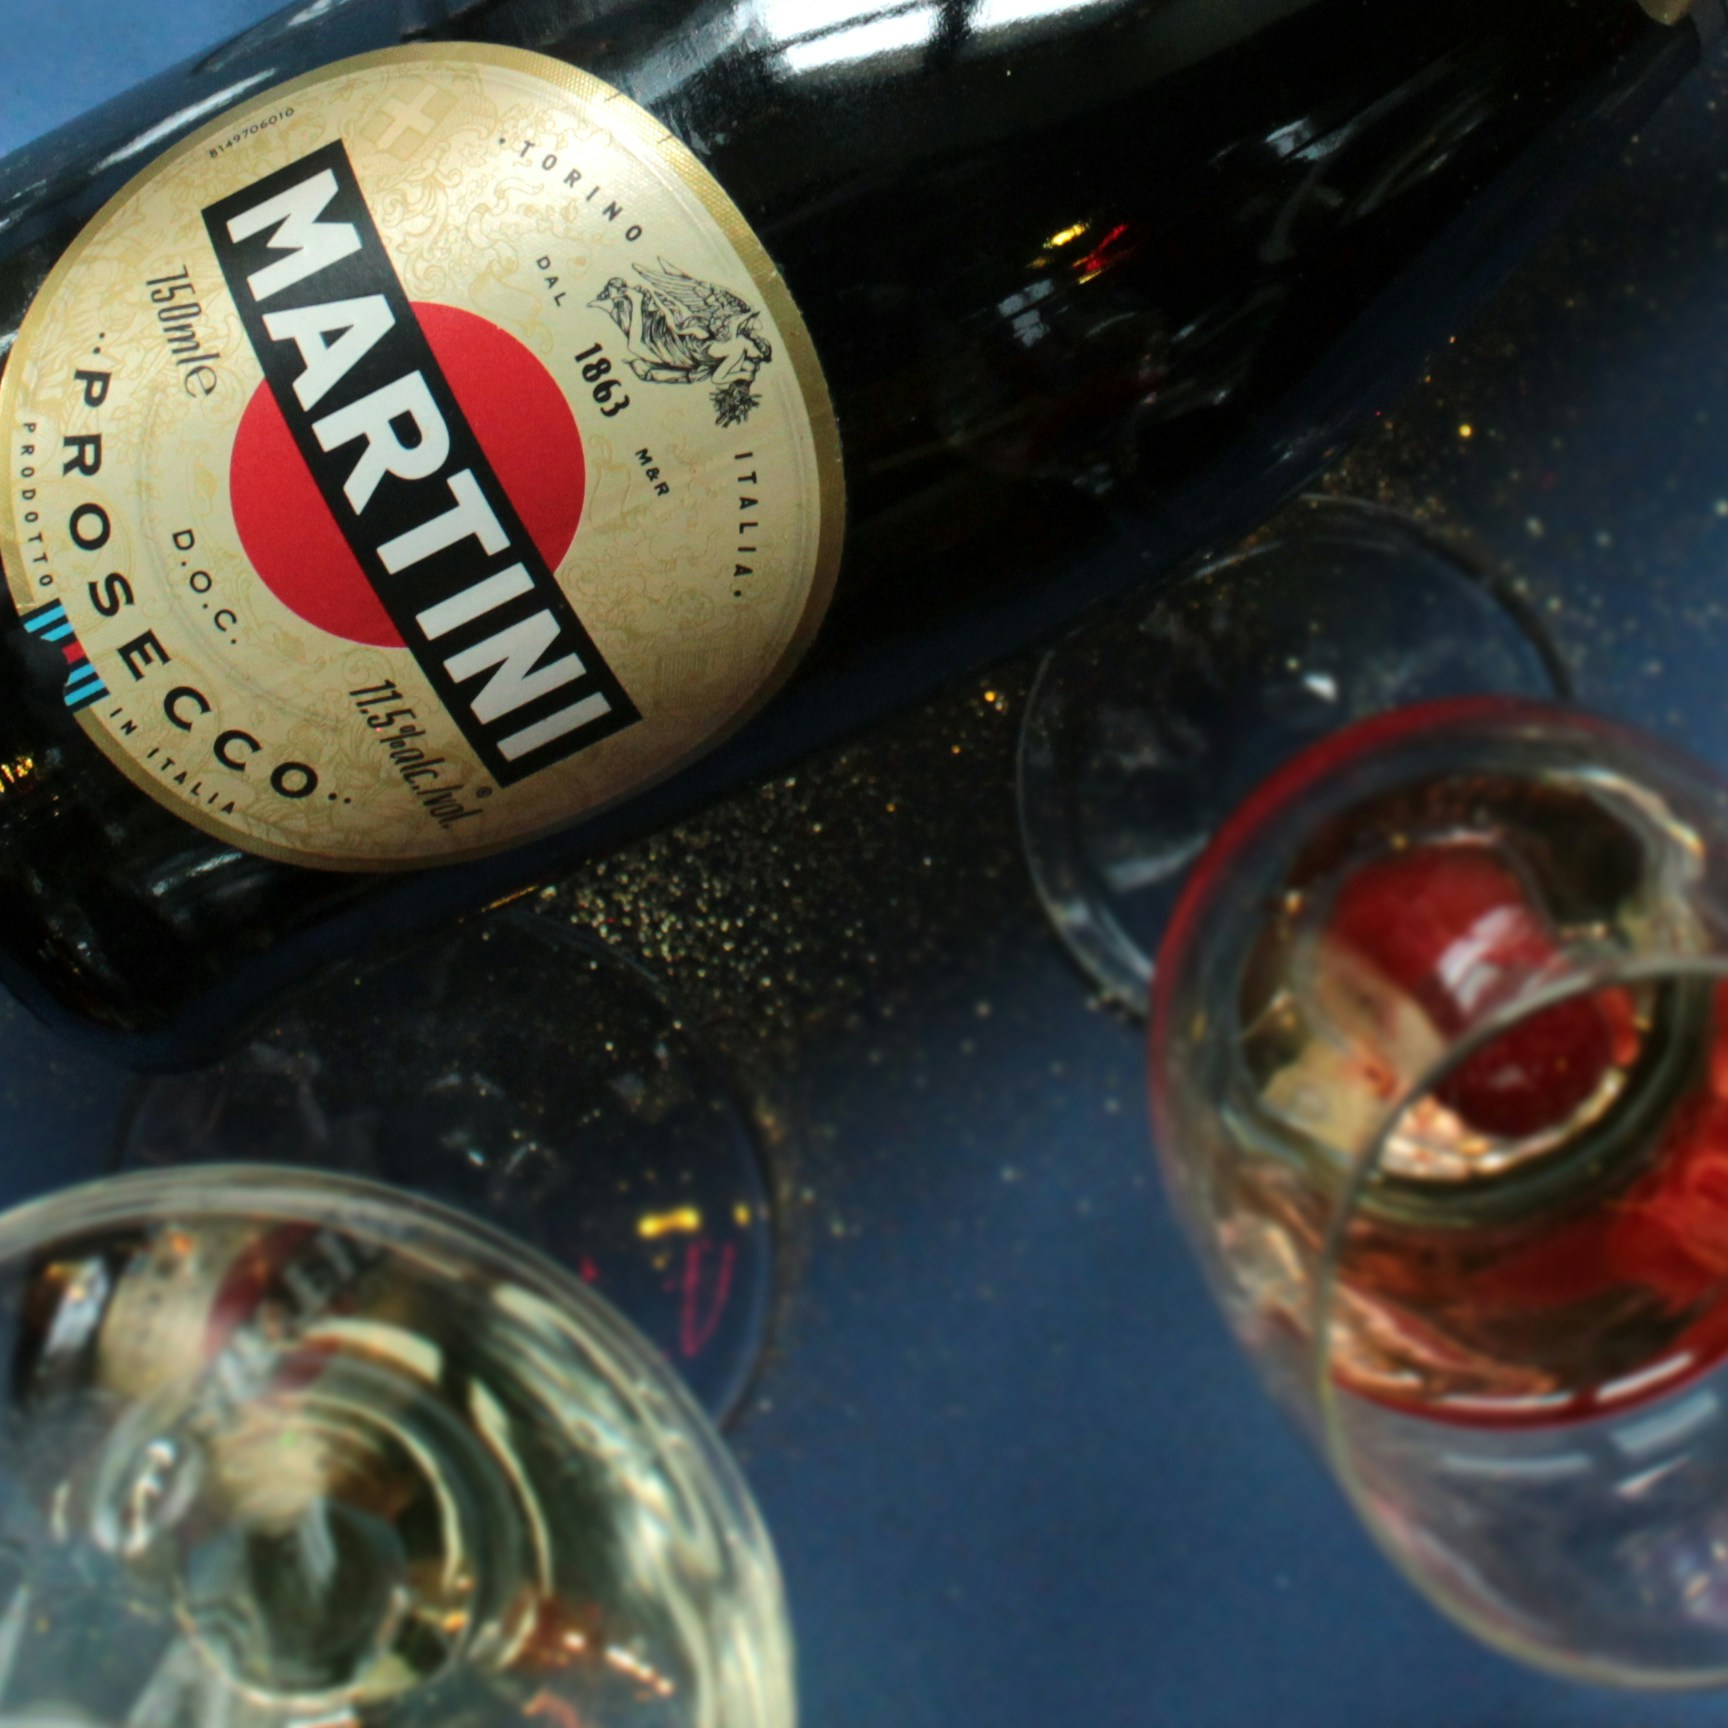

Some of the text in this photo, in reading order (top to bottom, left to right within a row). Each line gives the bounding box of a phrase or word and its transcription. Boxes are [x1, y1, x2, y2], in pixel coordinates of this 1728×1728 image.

[226, 167, 612, 762] MARTINI
[536, 255, 670, 498] DAL 1863 M&R
[20, 421, 237, 815] PRODOTTO IN ITALIA
[61, 369, 319, 799] PROSECCO
[172, 528, 238, 645] D.O.C.
